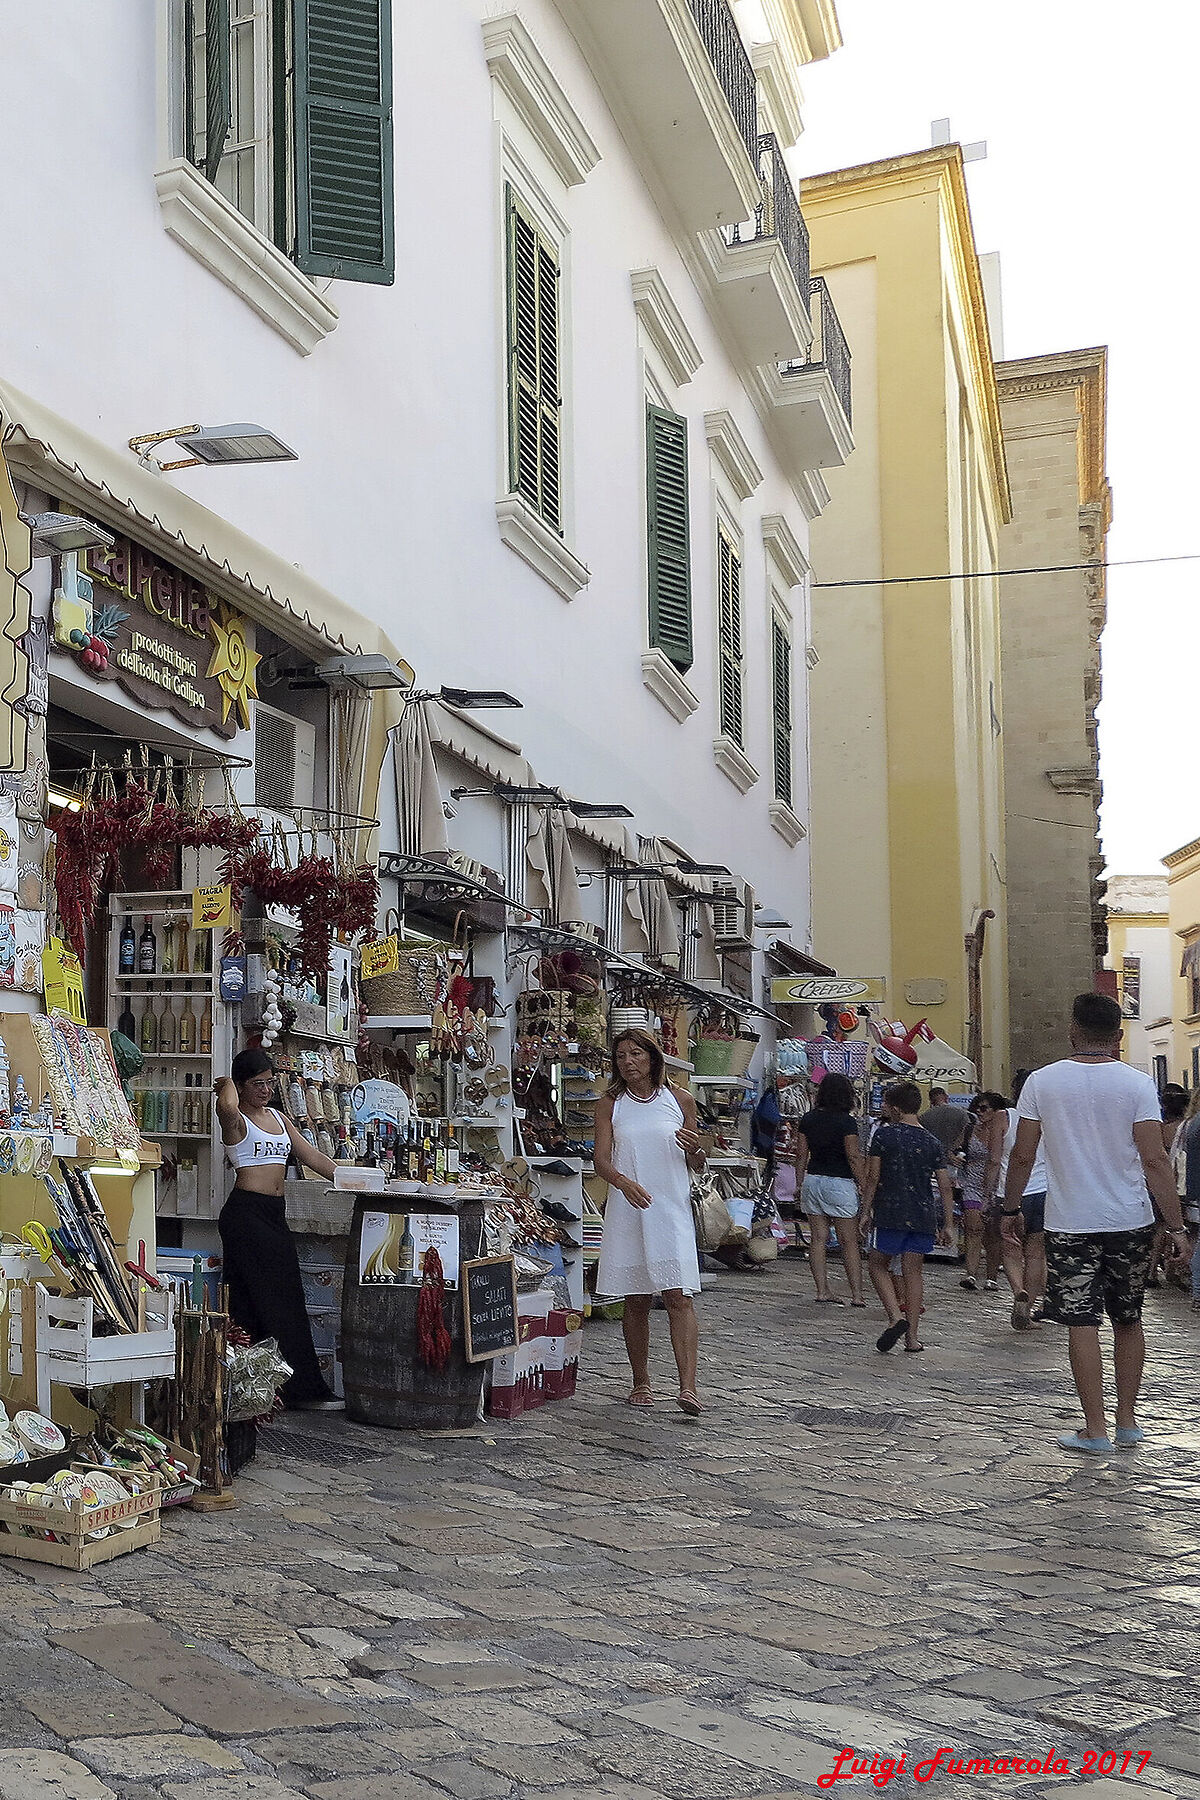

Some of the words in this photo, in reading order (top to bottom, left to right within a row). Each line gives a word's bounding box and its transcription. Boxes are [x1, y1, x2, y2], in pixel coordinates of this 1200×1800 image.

[131, 631, 173, 663] prodotti
[800, 979, 855, 1000] CREPES
[915, 1064, 967, 1079] rêpes
[253, 1141, 291, 1158] FRES
[87, 1494, 155, 1529] SPREAFICO
